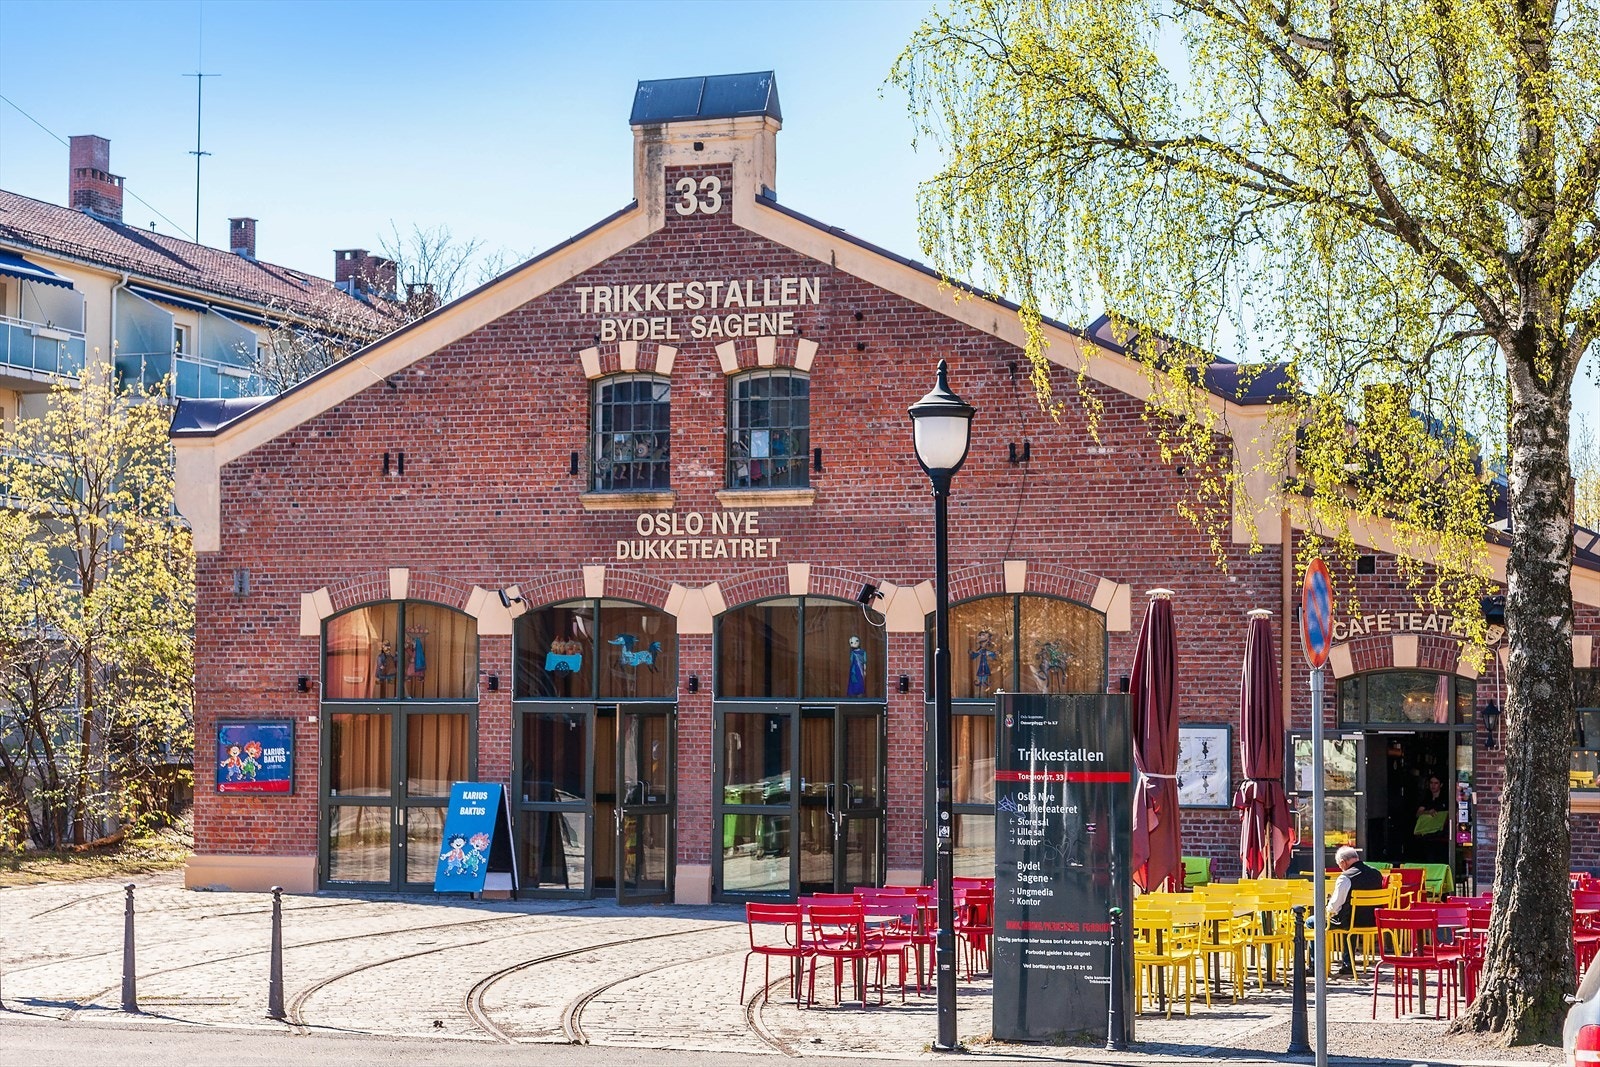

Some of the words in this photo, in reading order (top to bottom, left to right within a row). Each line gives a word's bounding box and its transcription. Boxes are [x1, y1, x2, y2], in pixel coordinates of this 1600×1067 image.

[674, 175, 722, 216] 33
[575, 276, 821, 314] TRIKKESTALLEN
[601, 316, 680, 342] BYDEL
[691, 312, 795, 338] SAGENE
[636, 511, 704, 536] OSLO
[711, 511, 760, 535] NYE
[616, 537, 781, 560] DUKKETEATRET
[1333, 609, 1391, 640] CAFÉ
[263, 747, 285, 756] KARIUS
[1017, 748, 1104, 762] Trikkestallen
[263, 755, 286, 763] BAKTUS
[1055, 773, 1065, 781] 33
[462, 791, 488, 800] KARIUS
[1017, 792, 1036, 801] Oslo
[1038, 792, 1055, 804] Nye
[459, 806, 486, 815] BAKTUS
[1017, 817, 1037, 826] Store
[1017, 827, 1033, 836] Lille
[1033, 828, 1045, 837] sal
[1017, 861, 1041, 872] Bydel
[1017, 872, 1049, 884] Sagene
[1016, 887, 1054, 897] Ungmedia
[1016, 897, 1041, 906] Kontor
